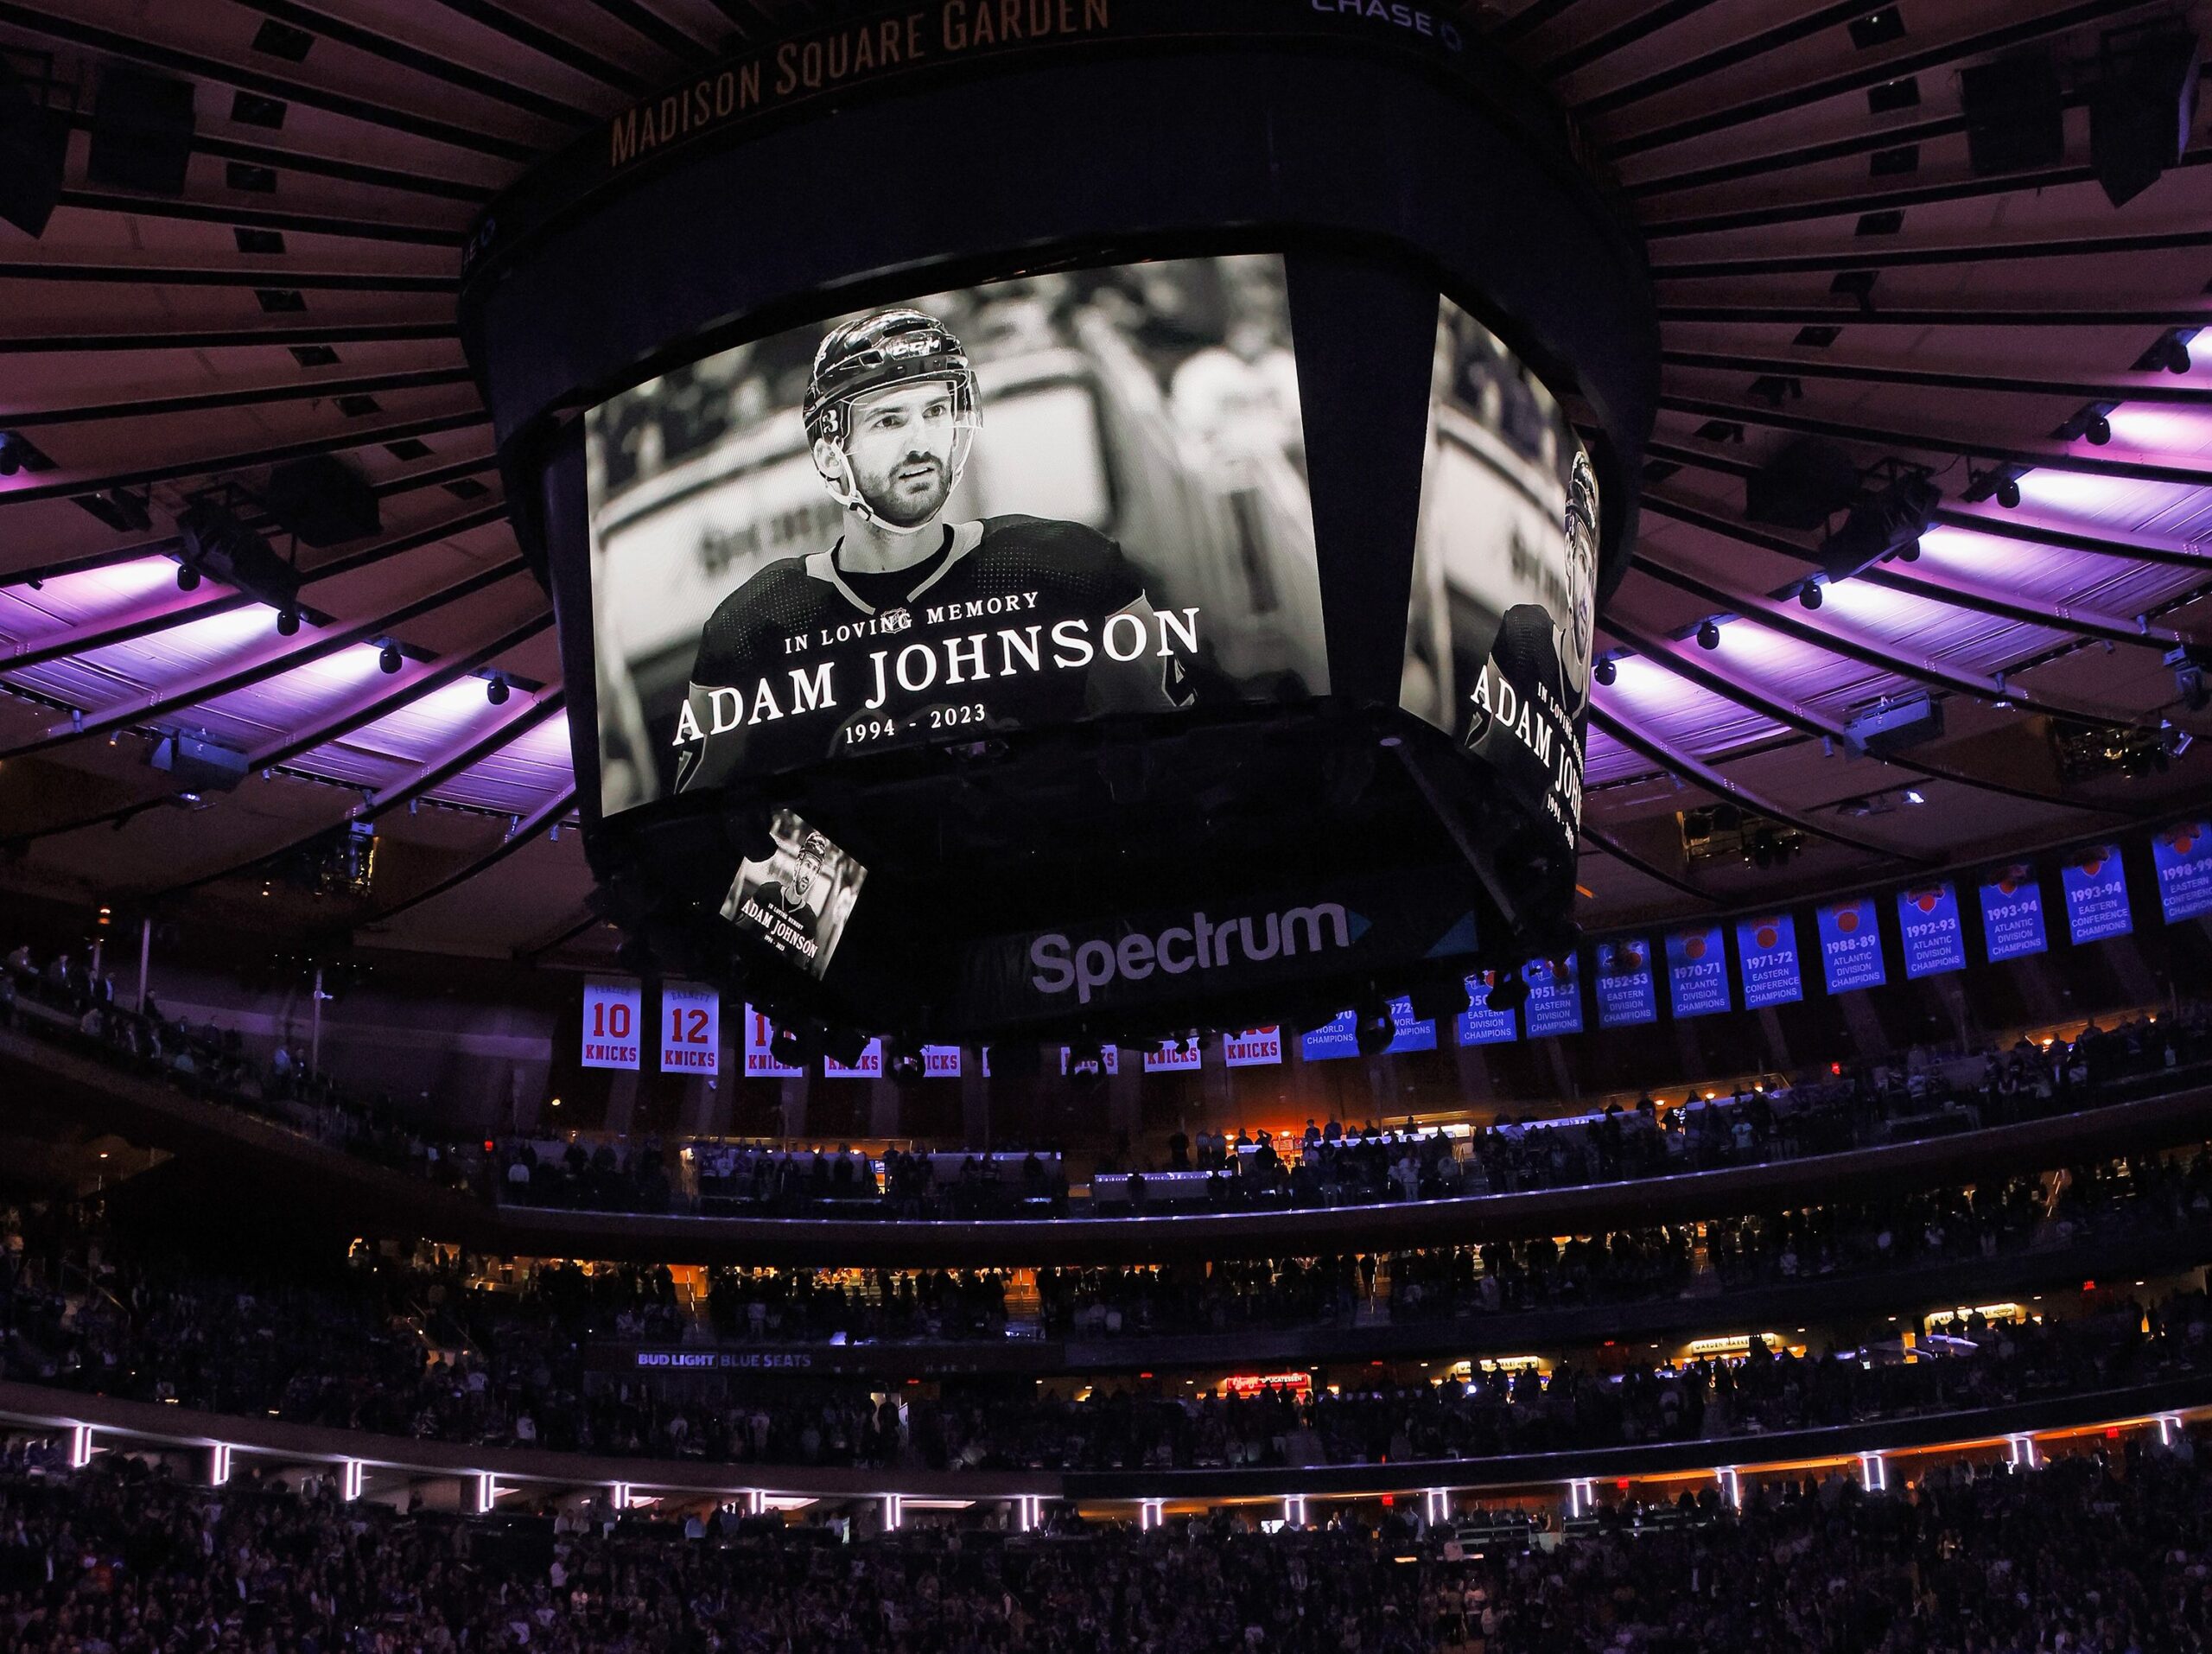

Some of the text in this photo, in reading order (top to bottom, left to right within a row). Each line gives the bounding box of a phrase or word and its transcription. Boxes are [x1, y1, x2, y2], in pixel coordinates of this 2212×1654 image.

[610, 0, 1109, 168] MADISON SQUARE GARDEN
[785, 634, 809, 654] IN
[822, 612, 912, 646] LOVING
[927, 591, 1039, 624] MEMORY
[672, 608, 1201, 746] ADAM JOHNSON
[844, 719, 896, 744] 1994
[931, 703, 987, 729] 2023
[1471, 665, 1553, 767] ADAM
[2070, 881, 2122, 903] 1993-94
[2163, 887, 2212, 907] CONFERENC
[1987, 900, 2037, 921] 1993-94
[2078, 900, 2117, 915] EASTERN
[2169, 899, 2212, 917] CHAMPION
[1994, 918, 2033, 933] ATLANTIC
[2071, 908, 2128, 928] CONFERENCE
[741, 900, 818, 959] ADAM JOHNSON
[1906, 918, 1956, 938] 1992-93
[1998, 929, 2033, 944] DIVISION
[2076, 919, 2126, 938] CHAMPIONS
[1827, 934, 1876, 955] 1988-89
[1913, 935, 1952, 951] ATLANTIC
[1993, 938, 2042, 955] CHAMPIONS
[1030, 902, 1349, 1004] Spectrum
[1746, 951, 1793, 970] 1971-72
[1834, 951, 1872, 966] ATLANTIC
[1916, 946, 1951, 960] DIVISION
[1674, 962, 1720, 979] 1970-71
[1837, 963, 1872, 976] DIVISION
[1910, 955, 1960, 972] CHAMPIONS
[1601, 973, 1648, 989] 1952-53
[1752, 968, 1789, 982] EASTERN
[1831, 971, 1880, 988] CHAMPIONS
[1530, 983, 1575, 999] 1951-52
[1680, 978, 1718, 991] ATLANTIC
[1745, 976, 1799, 994] CONFERENCE
[1606, 989, 1644, 1002] EASTERN
[1682, 989, 1717, 1002] DIVISION
[1750, 988, 1797, 1003] CHAMPIONS
[1535, 1000, 1571, 1011] EASTERN
[1610, 1000, 1643, 1011] DIVISION
[1677, 998, 1726, 1012] CHAMPIONS
[593, 1002, 631, 1038] 10
[1536, 1009, 1570, 1021] DIVISION
[1604, 1009, 1651, 1022] CHAMPIONS
[671, 1008, 709, 1044] 12
[1394, 1026, 1431, 1036] AMPIONS
[1470, 1019, 1504, 1029] DIVISION
[1531, 1019, 1578, 1033] CHAMPIONS
[1306, 1034, 1353, 1045] CHAMPIONS
[1464, 1027, 1511, 1040] CHAMPIONS
[585, 1044, 637, 1062] KNICKS
[664, 1050, 715, 1067] KNICKS
[1226, 1040, 1279, 1060] KNICKS
[638, 1353, 811, 1367] BUD LIGHT BLUE SEATS
